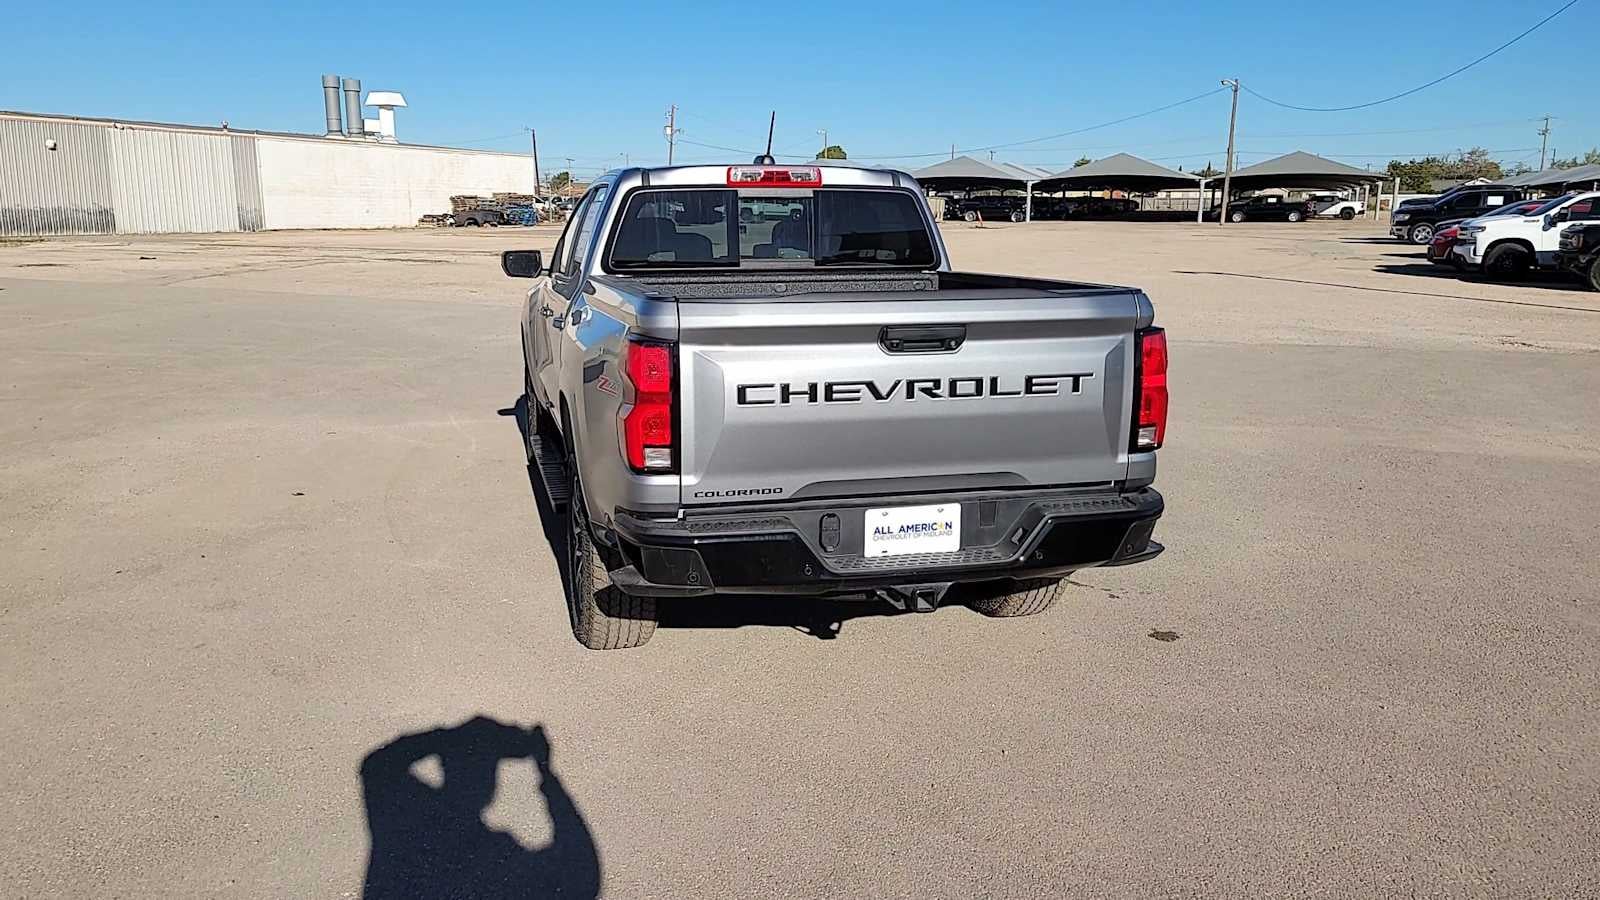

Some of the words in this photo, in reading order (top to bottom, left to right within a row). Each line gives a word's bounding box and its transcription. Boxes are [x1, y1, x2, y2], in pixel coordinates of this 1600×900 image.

[736, 371, 1094, 406] CHEVROLET
[694, 487, 783, 498] COLORADO
[873, 525, 893, 535] ALL
[872, 533, 911, 542] CHEVROLET
